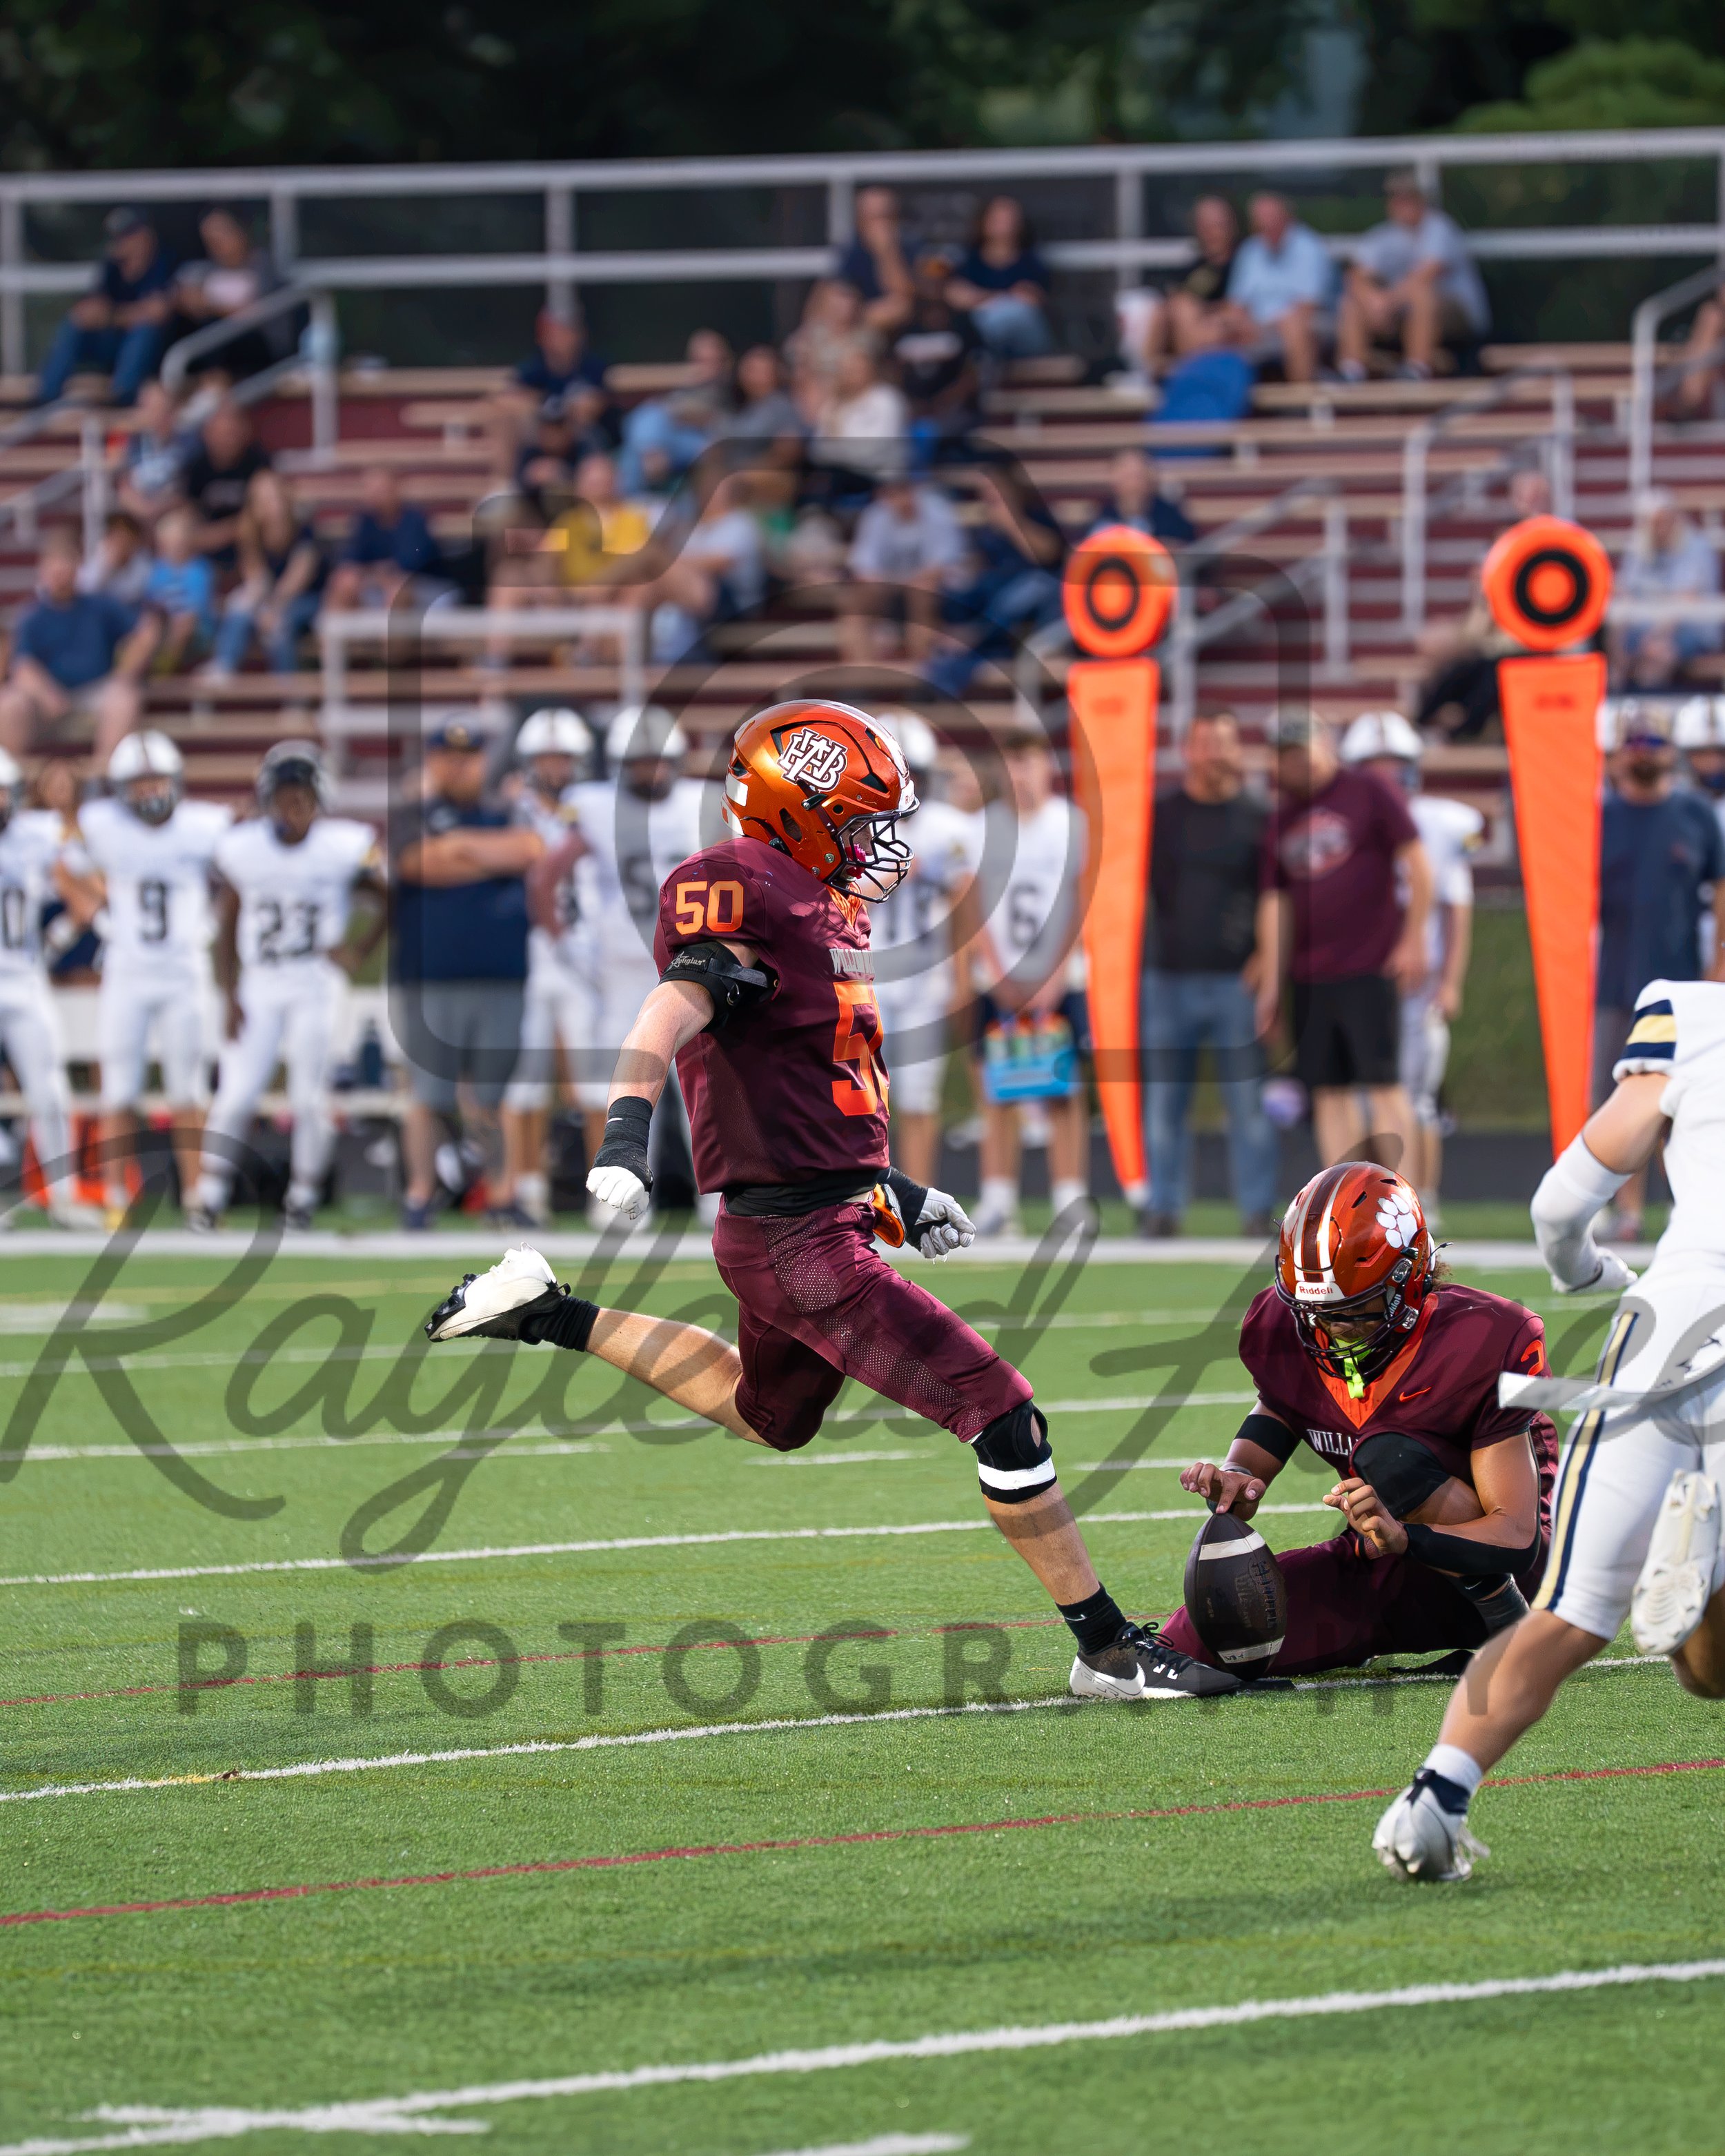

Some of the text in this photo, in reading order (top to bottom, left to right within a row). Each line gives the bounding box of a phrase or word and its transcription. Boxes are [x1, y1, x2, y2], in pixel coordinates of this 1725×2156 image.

[141, 880, 166, 940] 9
[257, 902, 321, 960] 23
[675, 880, 744, 934] 50
[1007, 882, 1041, 949] 6
[1299, 1286, 1333, 1296] Riddell
